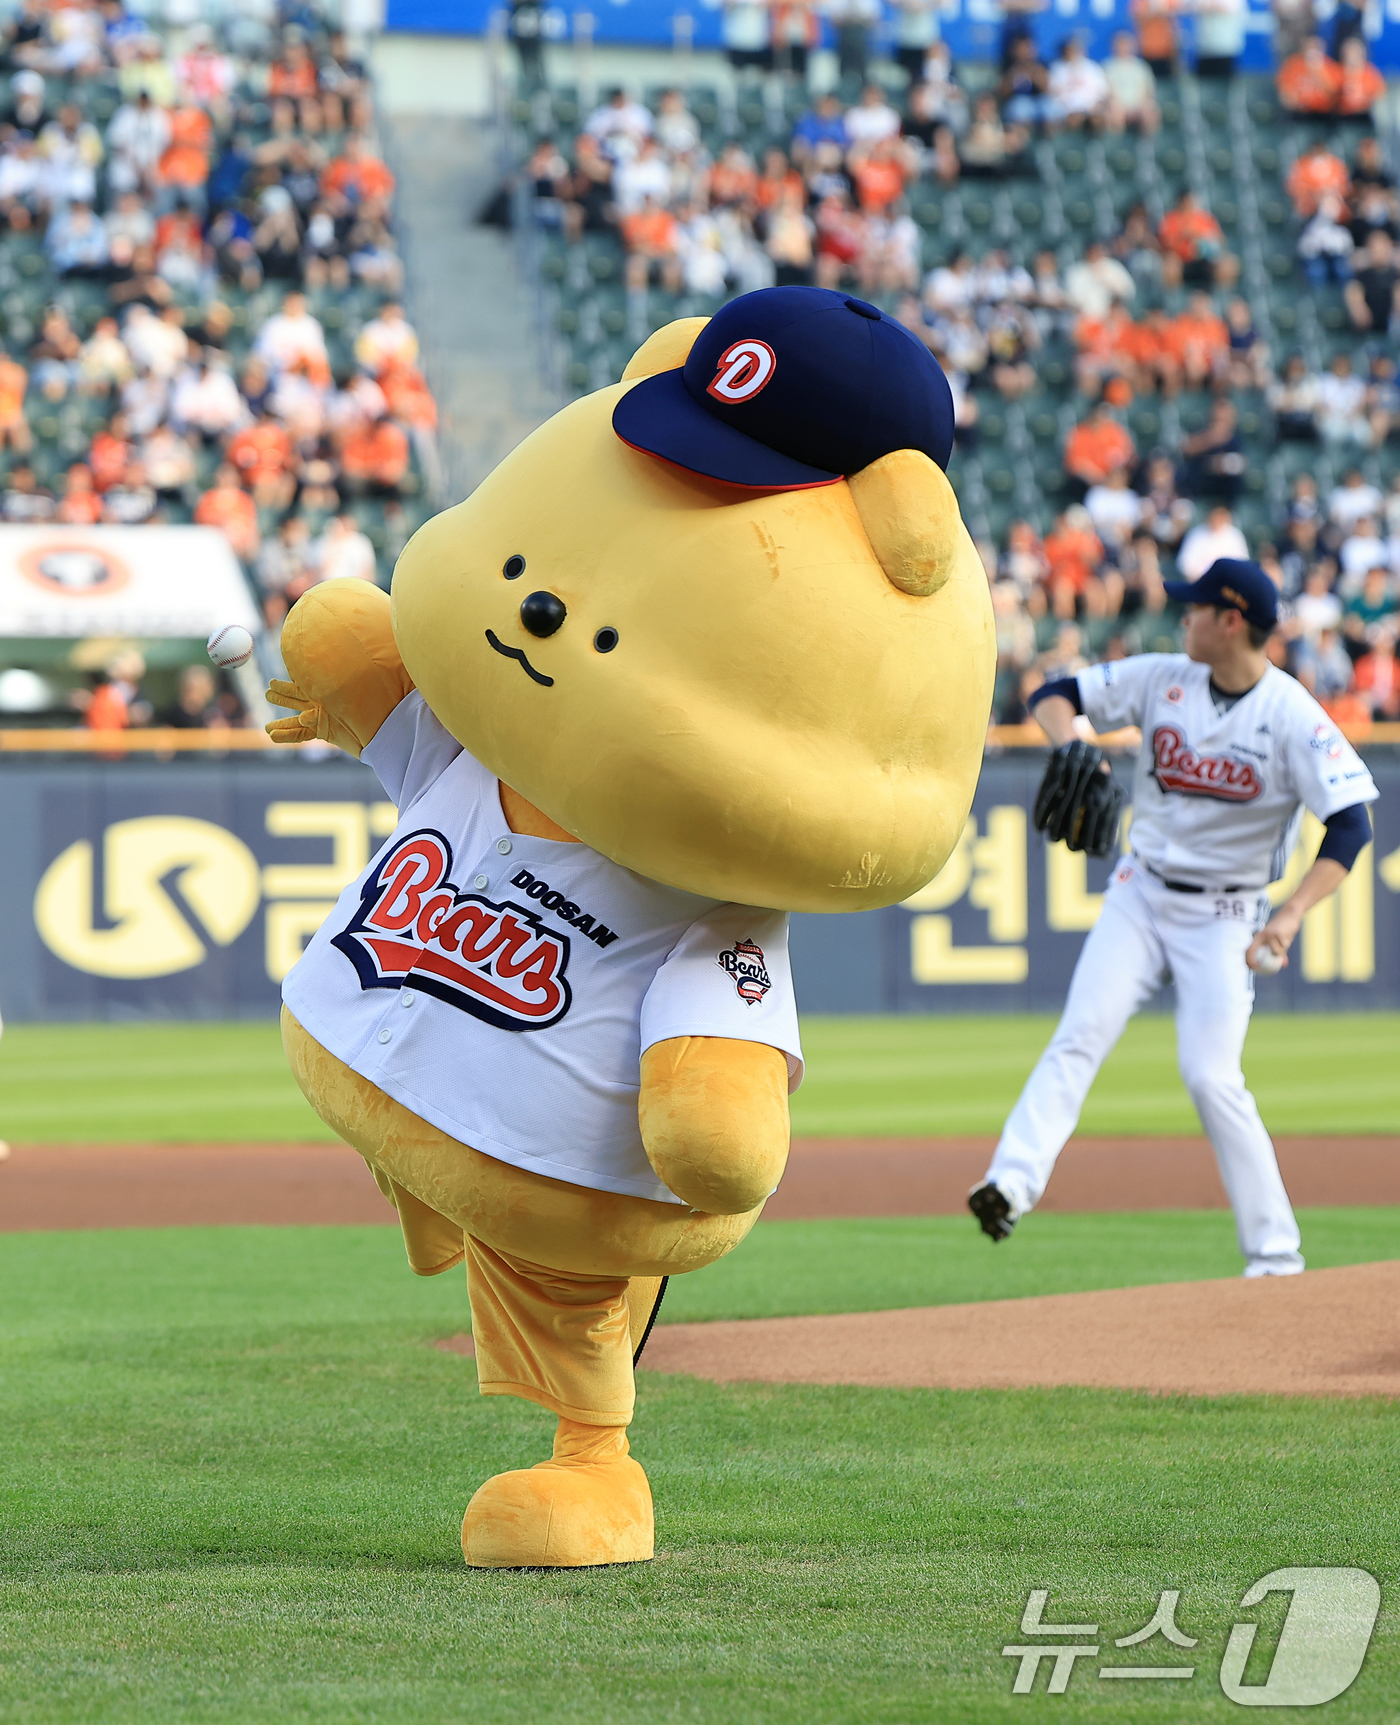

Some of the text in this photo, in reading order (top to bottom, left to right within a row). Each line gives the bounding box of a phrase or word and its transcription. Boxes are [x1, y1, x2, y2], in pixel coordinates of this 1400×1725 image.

[706, 339, 776, 404] D
[1150, 722, 1265, 804] Bears
[334, 830, 571, 1028] Bears
[510, 869, 619, 948] DOOSAN
[718, 950, 771, 988] Bears
